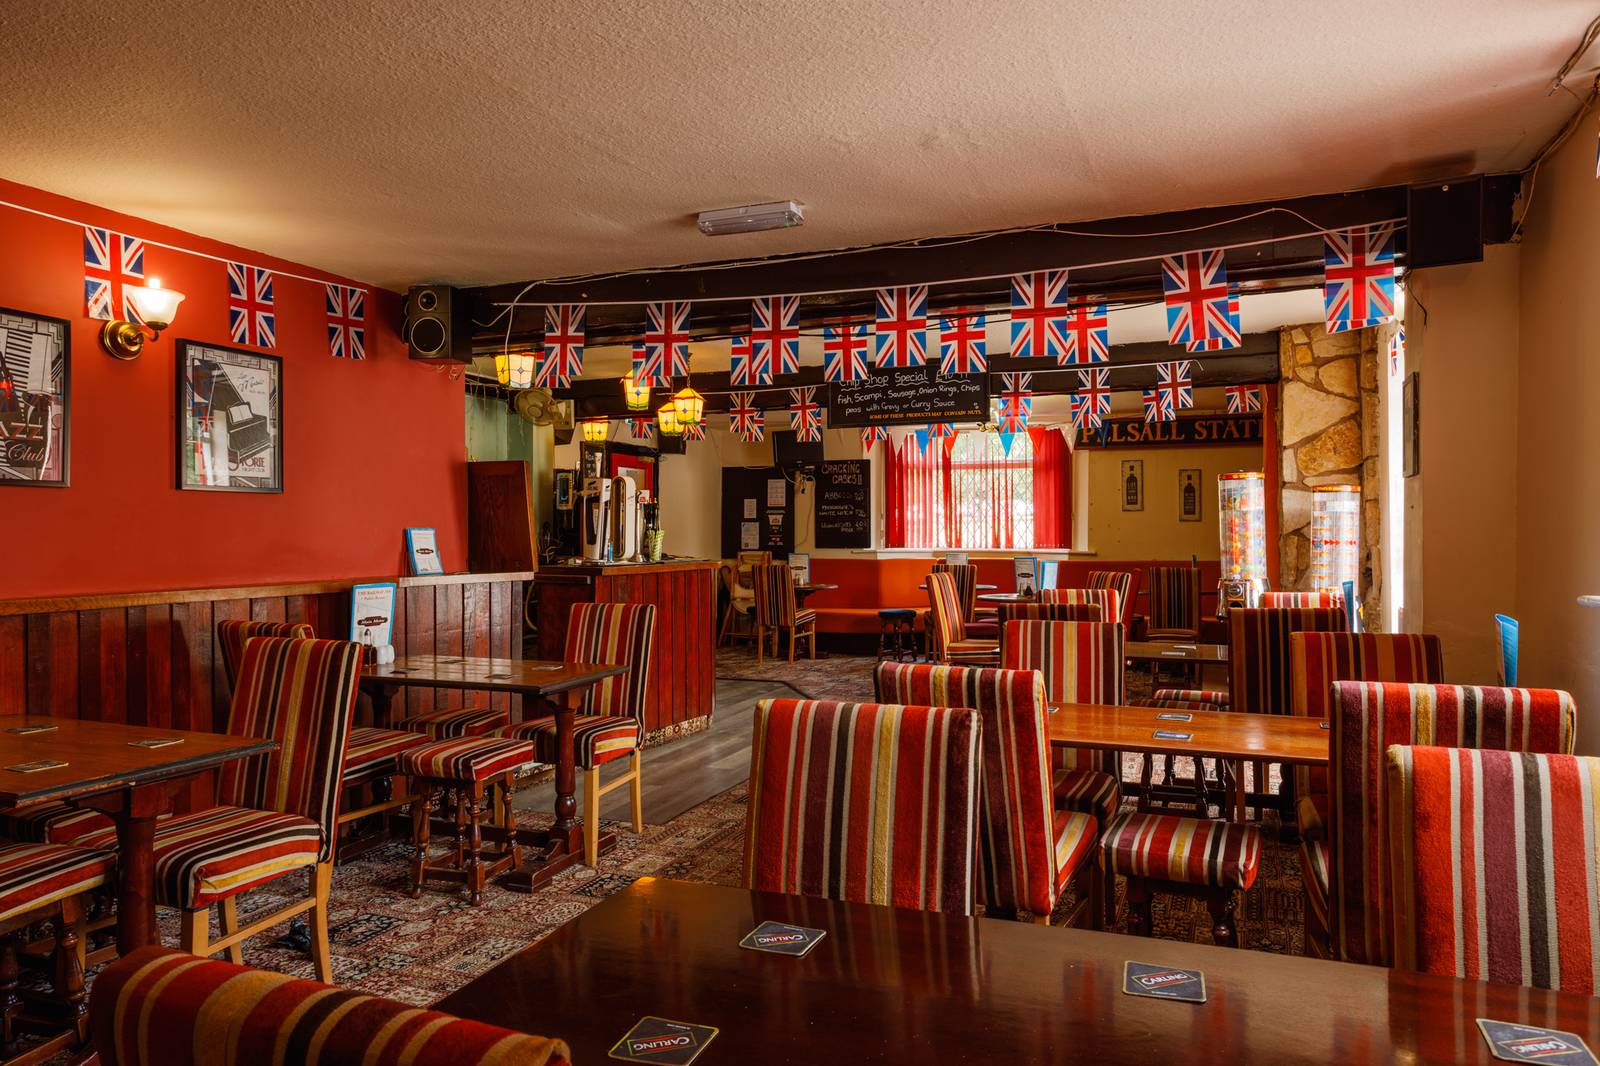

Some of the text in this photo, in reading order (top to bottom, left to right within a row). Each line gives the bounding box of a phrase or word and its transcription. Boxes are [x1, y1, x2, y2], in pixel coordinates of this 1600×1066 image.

[895, 369, 928, 385] Special
[911, 400, 931, 411] Curry
[1081, 422, 1185, 442] PLSALL
[5, 440, 44, 461] Club
[758, 934, 803, 944] CARLING
[633, 1036, 690, 1051] CARLING
